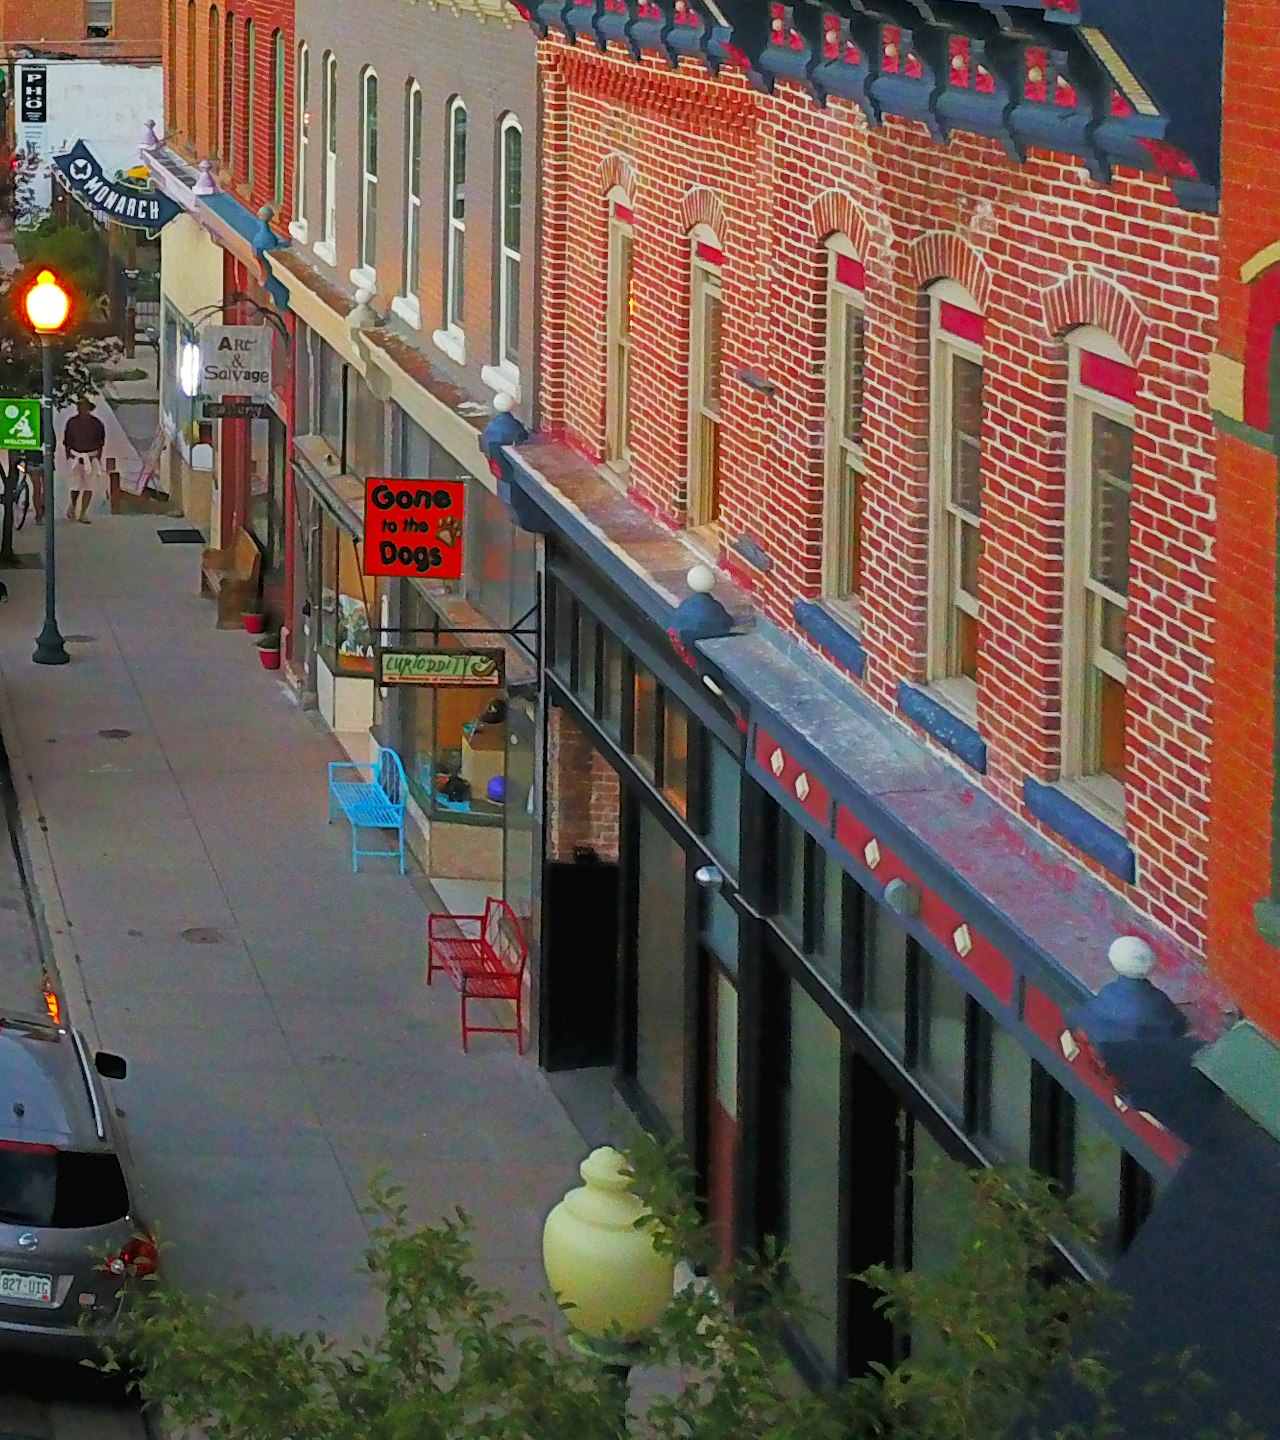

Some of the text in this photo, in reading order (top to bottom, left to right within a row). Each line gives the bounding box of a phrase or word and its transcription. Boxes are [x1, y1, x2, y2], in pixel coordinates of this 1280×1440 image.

[83, 175, 160, 220] MONARCH
[232, 353, 245, 368] &
[204, 365, 269, 383] Salvage
[371, 485, 452, 510] Gone
[382, 517, 429, 534] to the
[380, 541, 443, 572] Dogs
